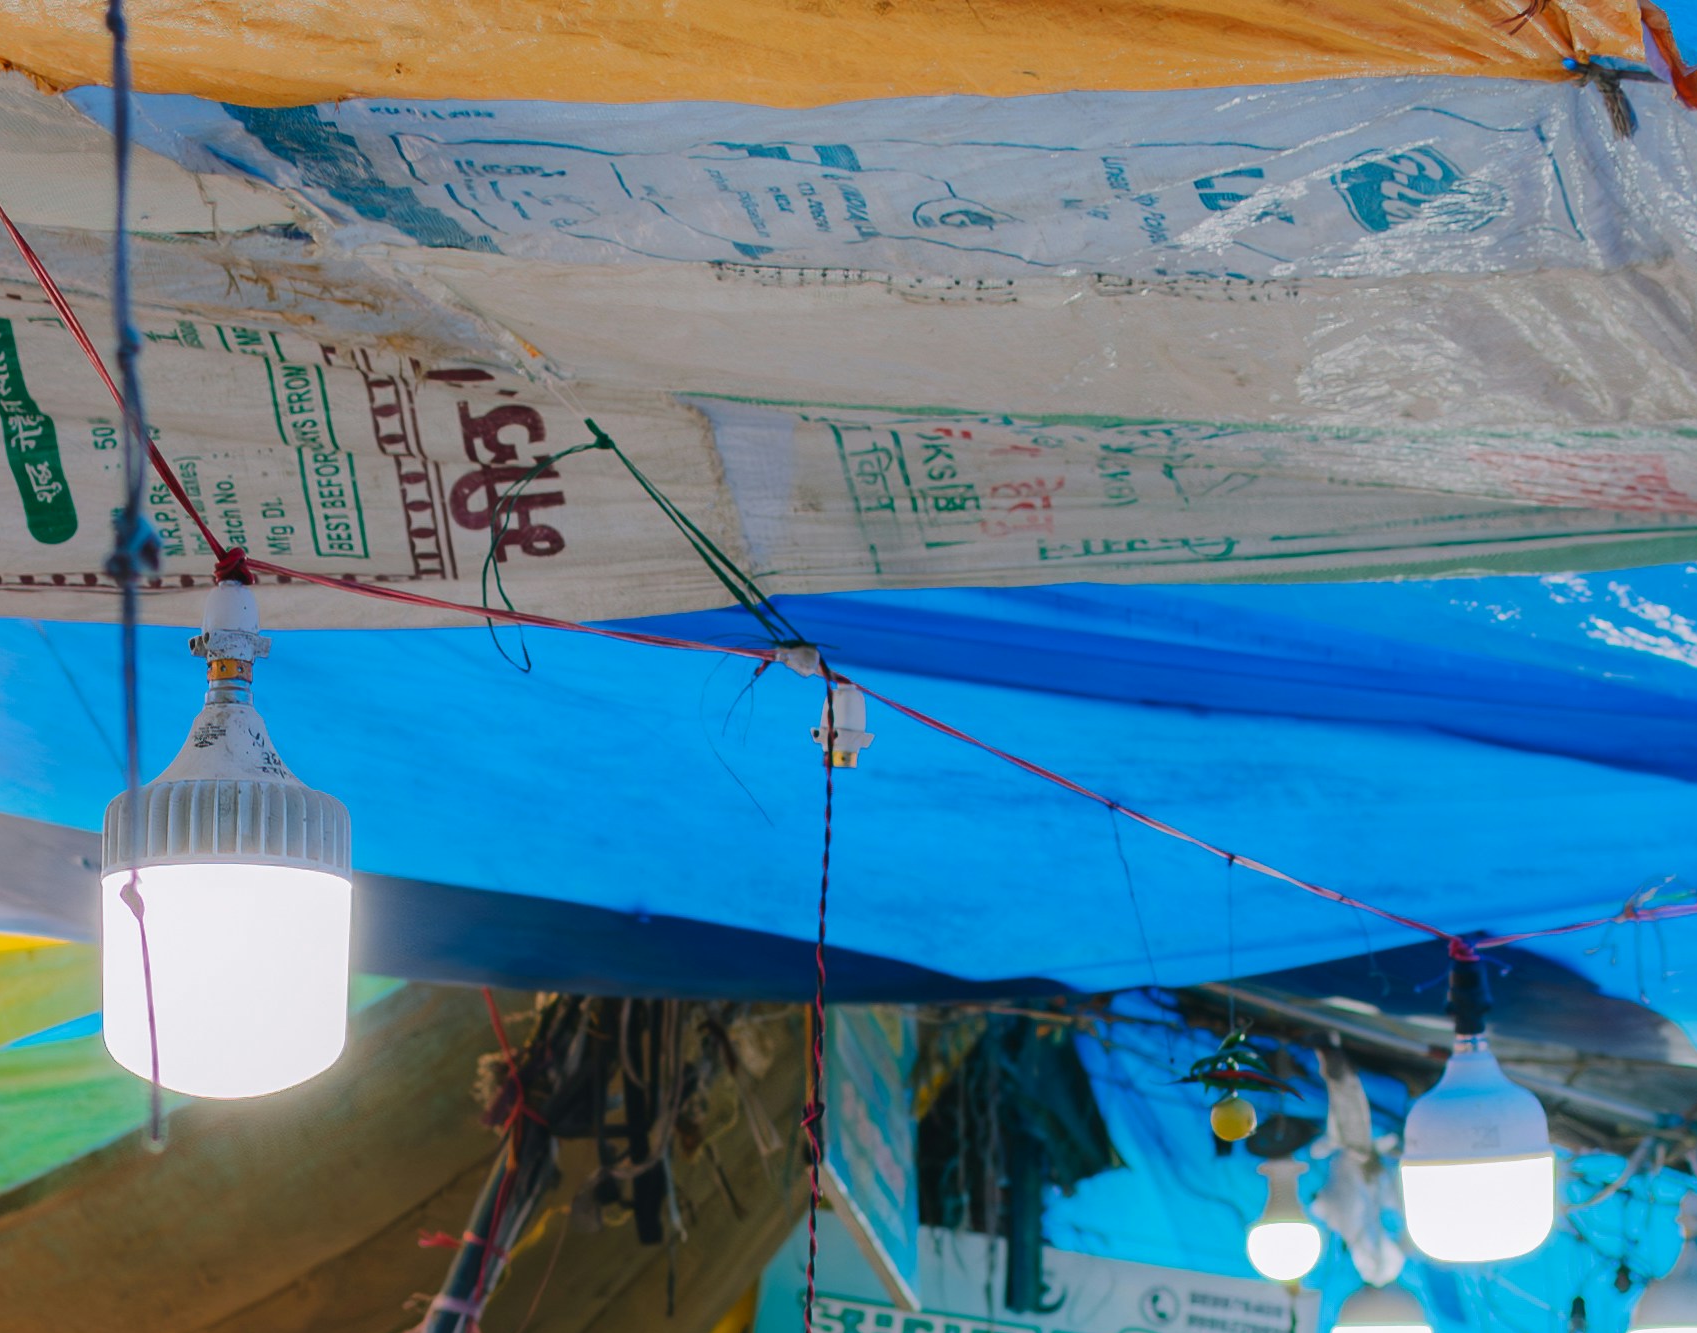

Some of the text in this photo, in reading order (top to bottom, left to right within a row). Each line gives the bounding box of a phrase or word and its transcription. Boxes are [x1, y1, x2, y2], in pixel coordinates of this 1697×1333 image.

[281, 364, 315, 416] FROM
[313, 448, 349, 513] BEFOR
[265, 525, 295, 556] Mfg
[322, 513, 355, 552] BEST
